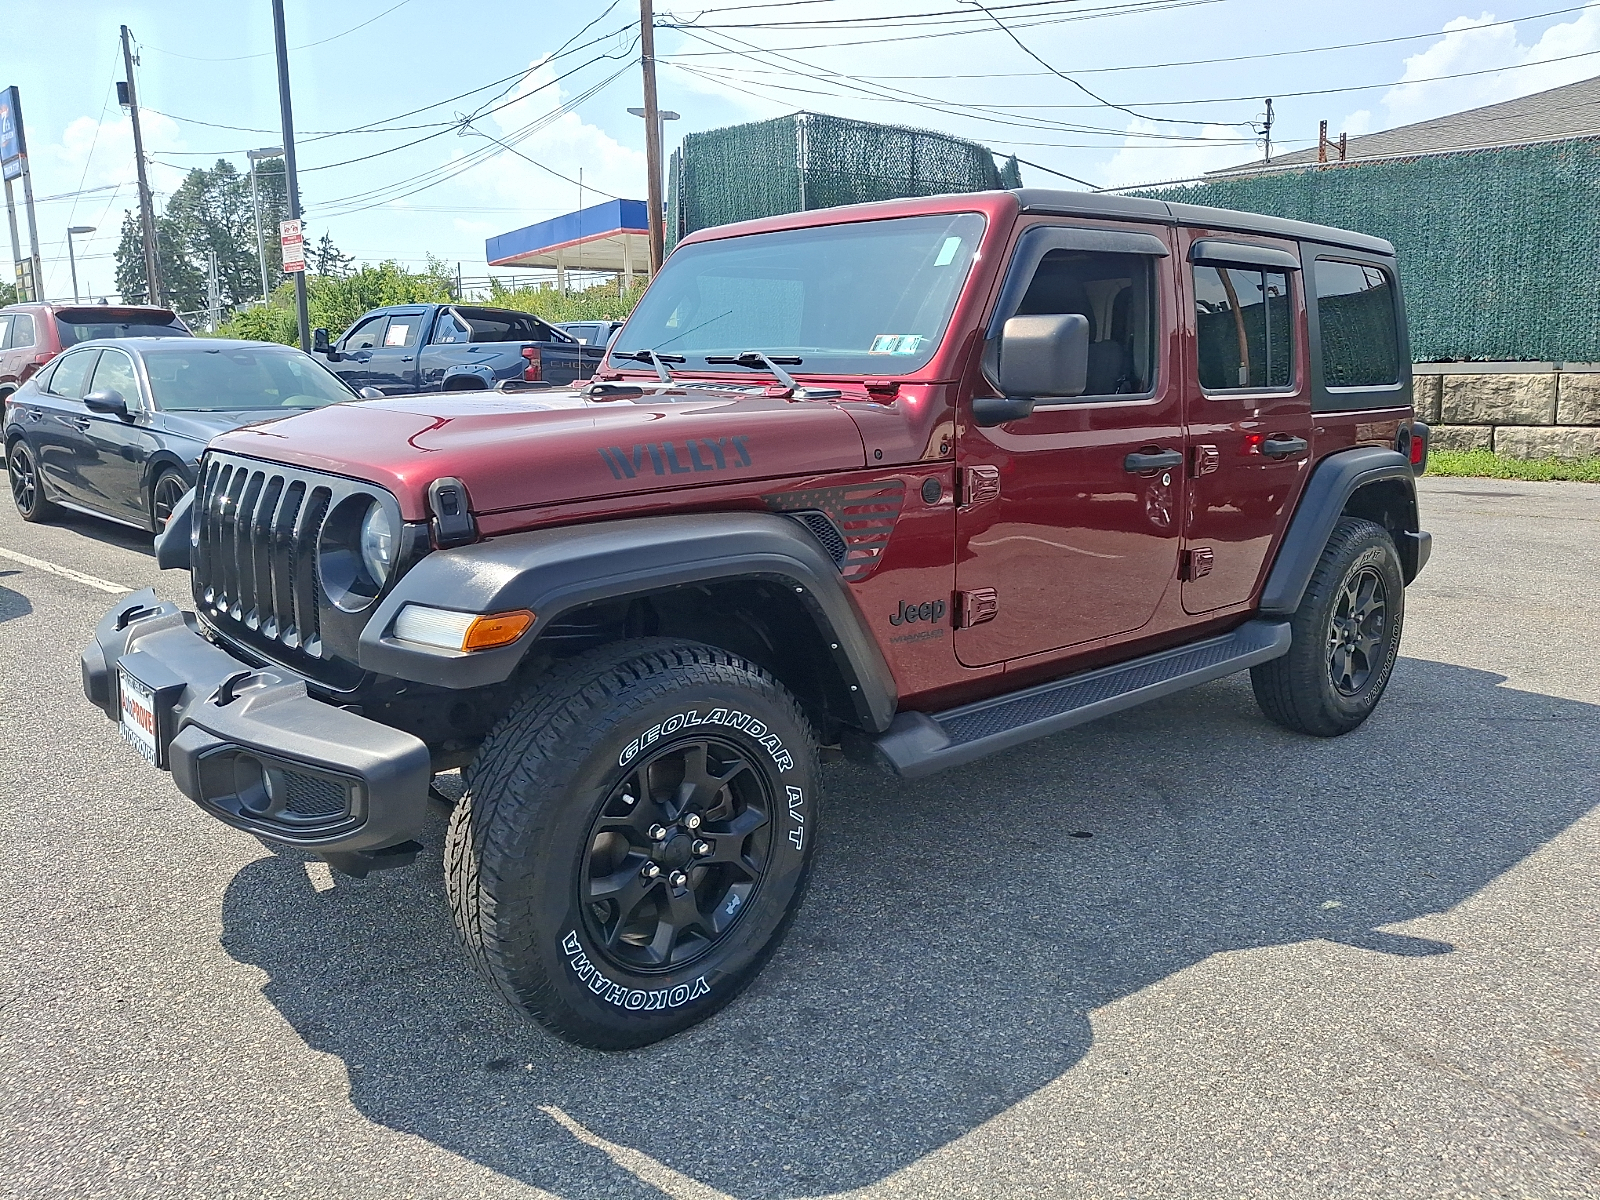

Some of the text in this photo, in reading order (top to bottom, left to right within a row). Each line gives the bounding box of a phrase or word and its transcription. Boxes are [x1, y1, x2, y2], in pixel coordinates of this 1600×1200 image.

[597, 435, 752, 480] WILLYS
[889, 600, 946, 626] Jeep
[619, 707, 804, 850] GEOLANDAR A/T
[562, 930, 710, 1011] YOKOHAMA
